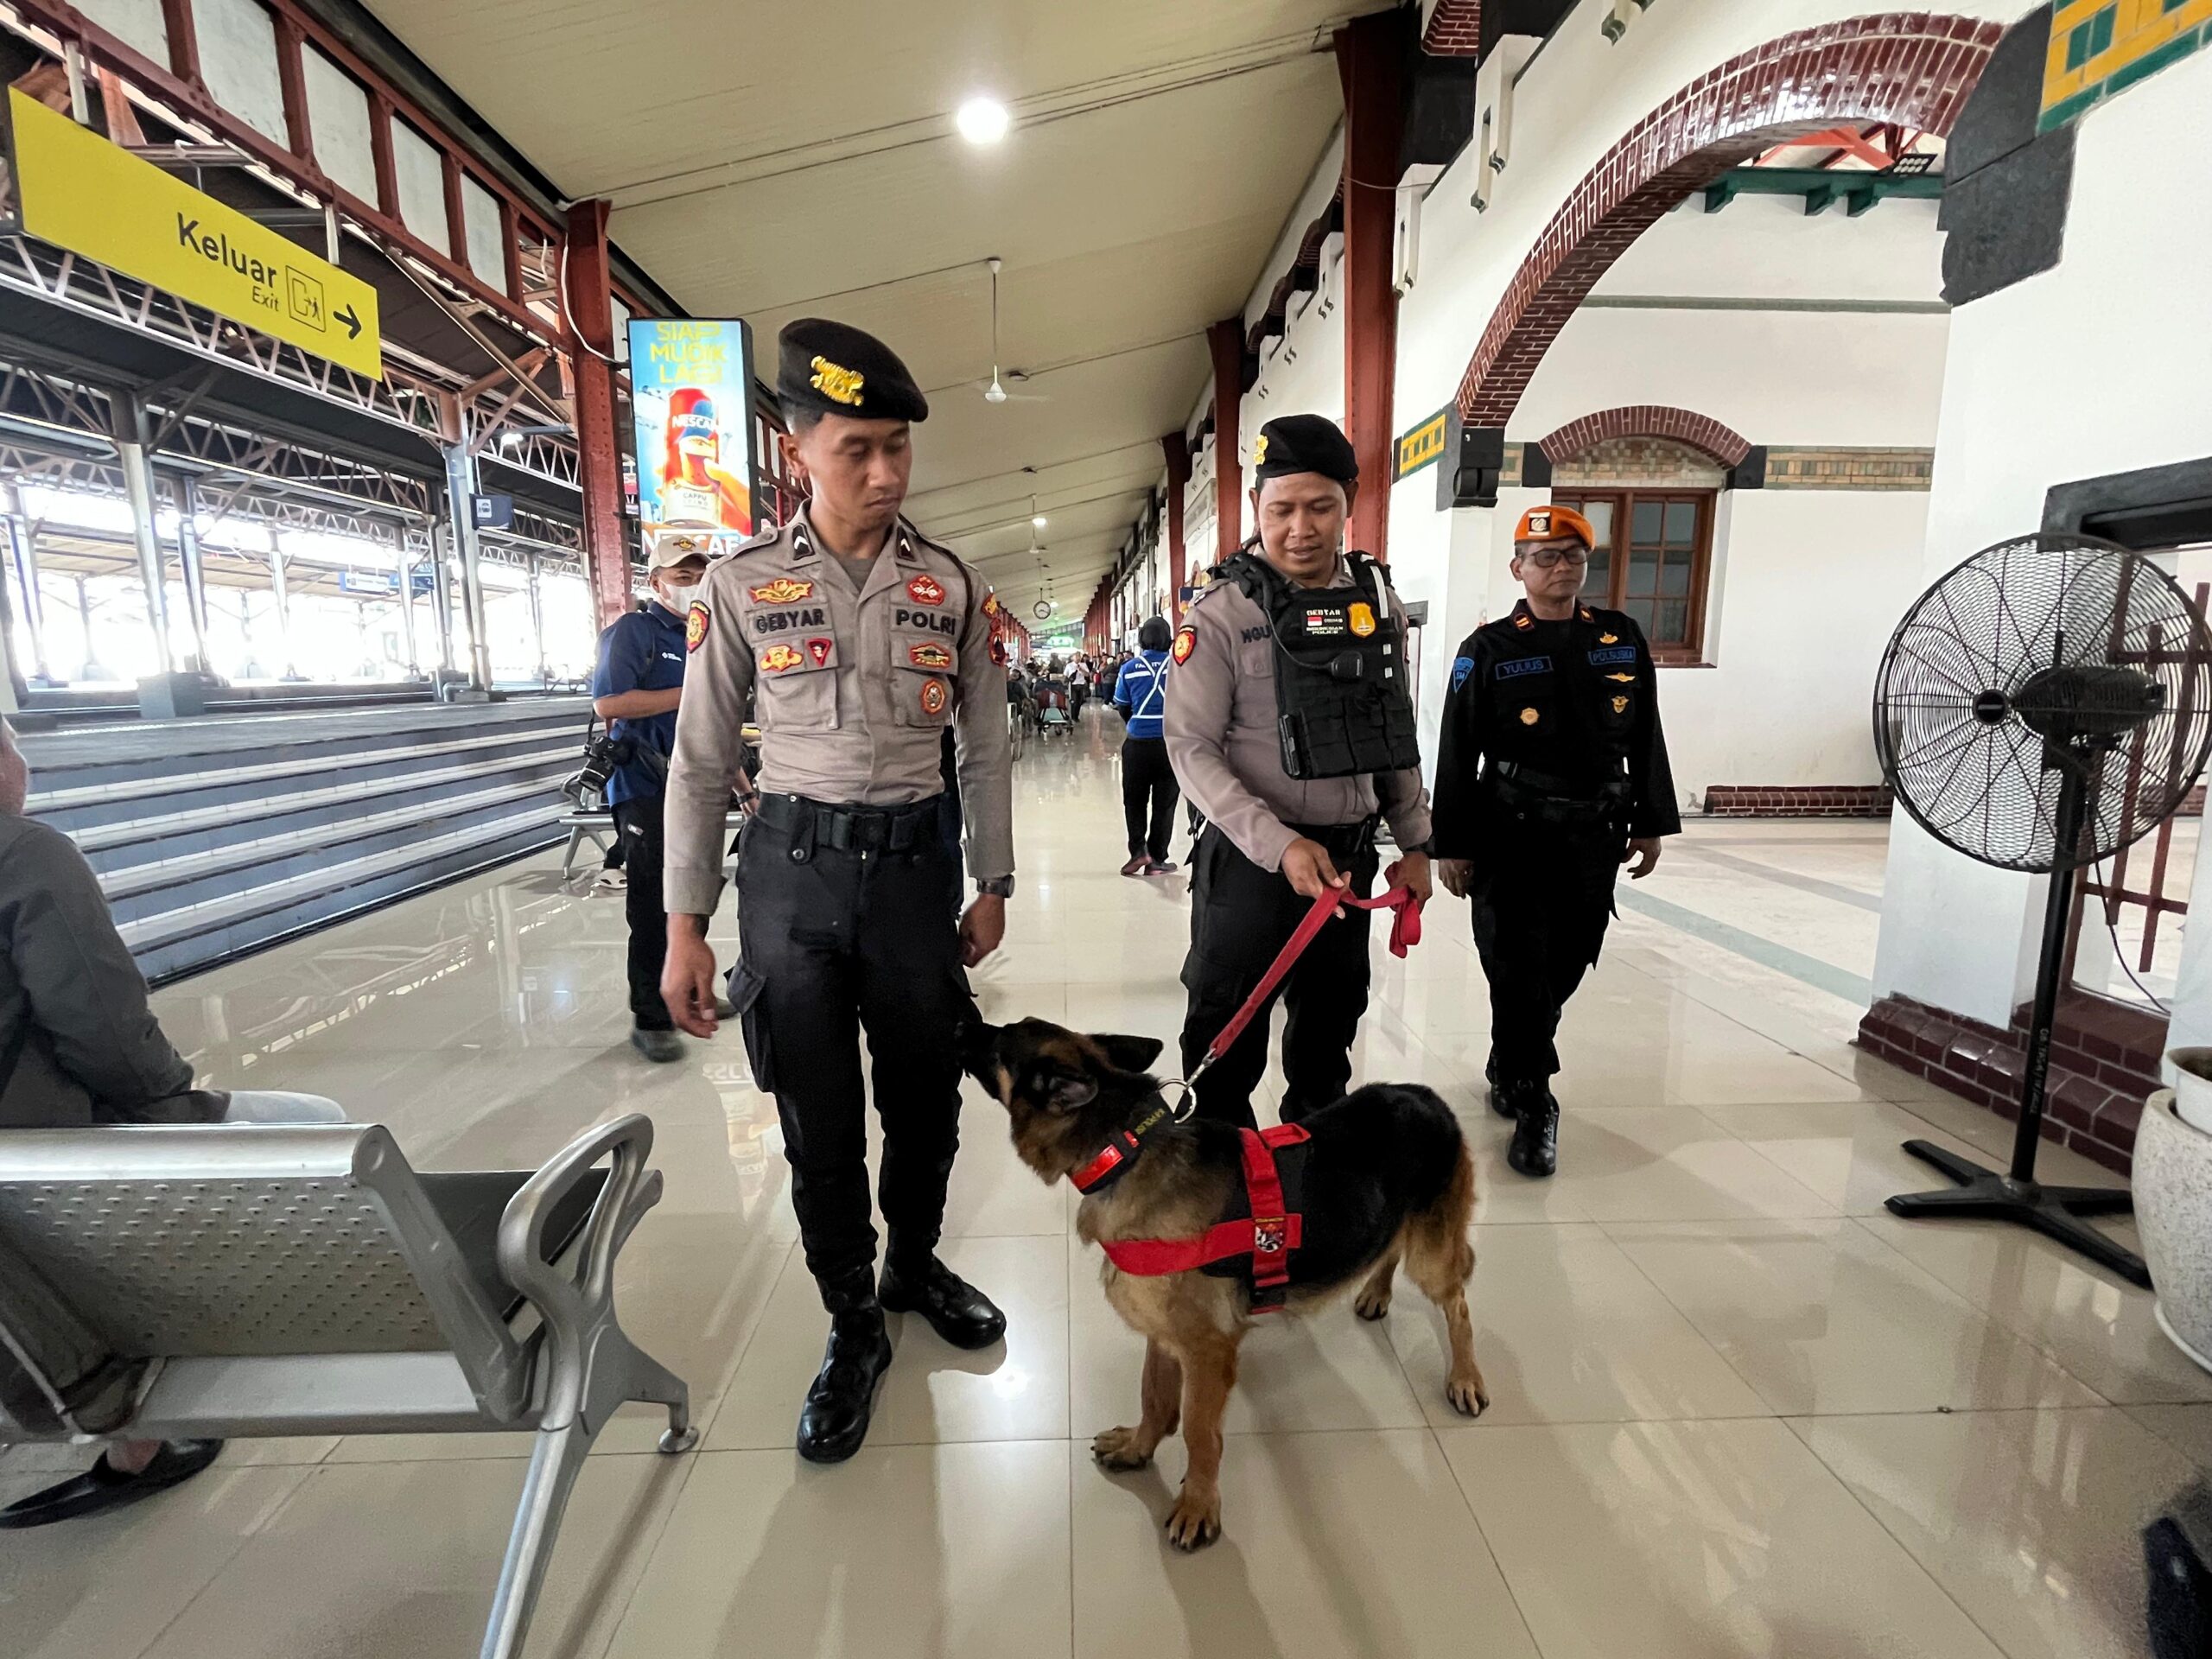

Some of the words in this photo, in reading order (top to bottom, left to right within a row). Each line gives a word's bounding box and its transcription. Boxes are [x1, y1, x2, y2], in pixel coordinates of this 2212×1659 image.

[177, 211, 276, 288] Keluar
[251, 285, 278, 311] Exit
[656, 322, 721, 342] SIAP
[755, 608, 825, 633] GEBYAR
[895, 609, 956, 635] POLRI
[1503, 659, 1544, 675] YULIUS
